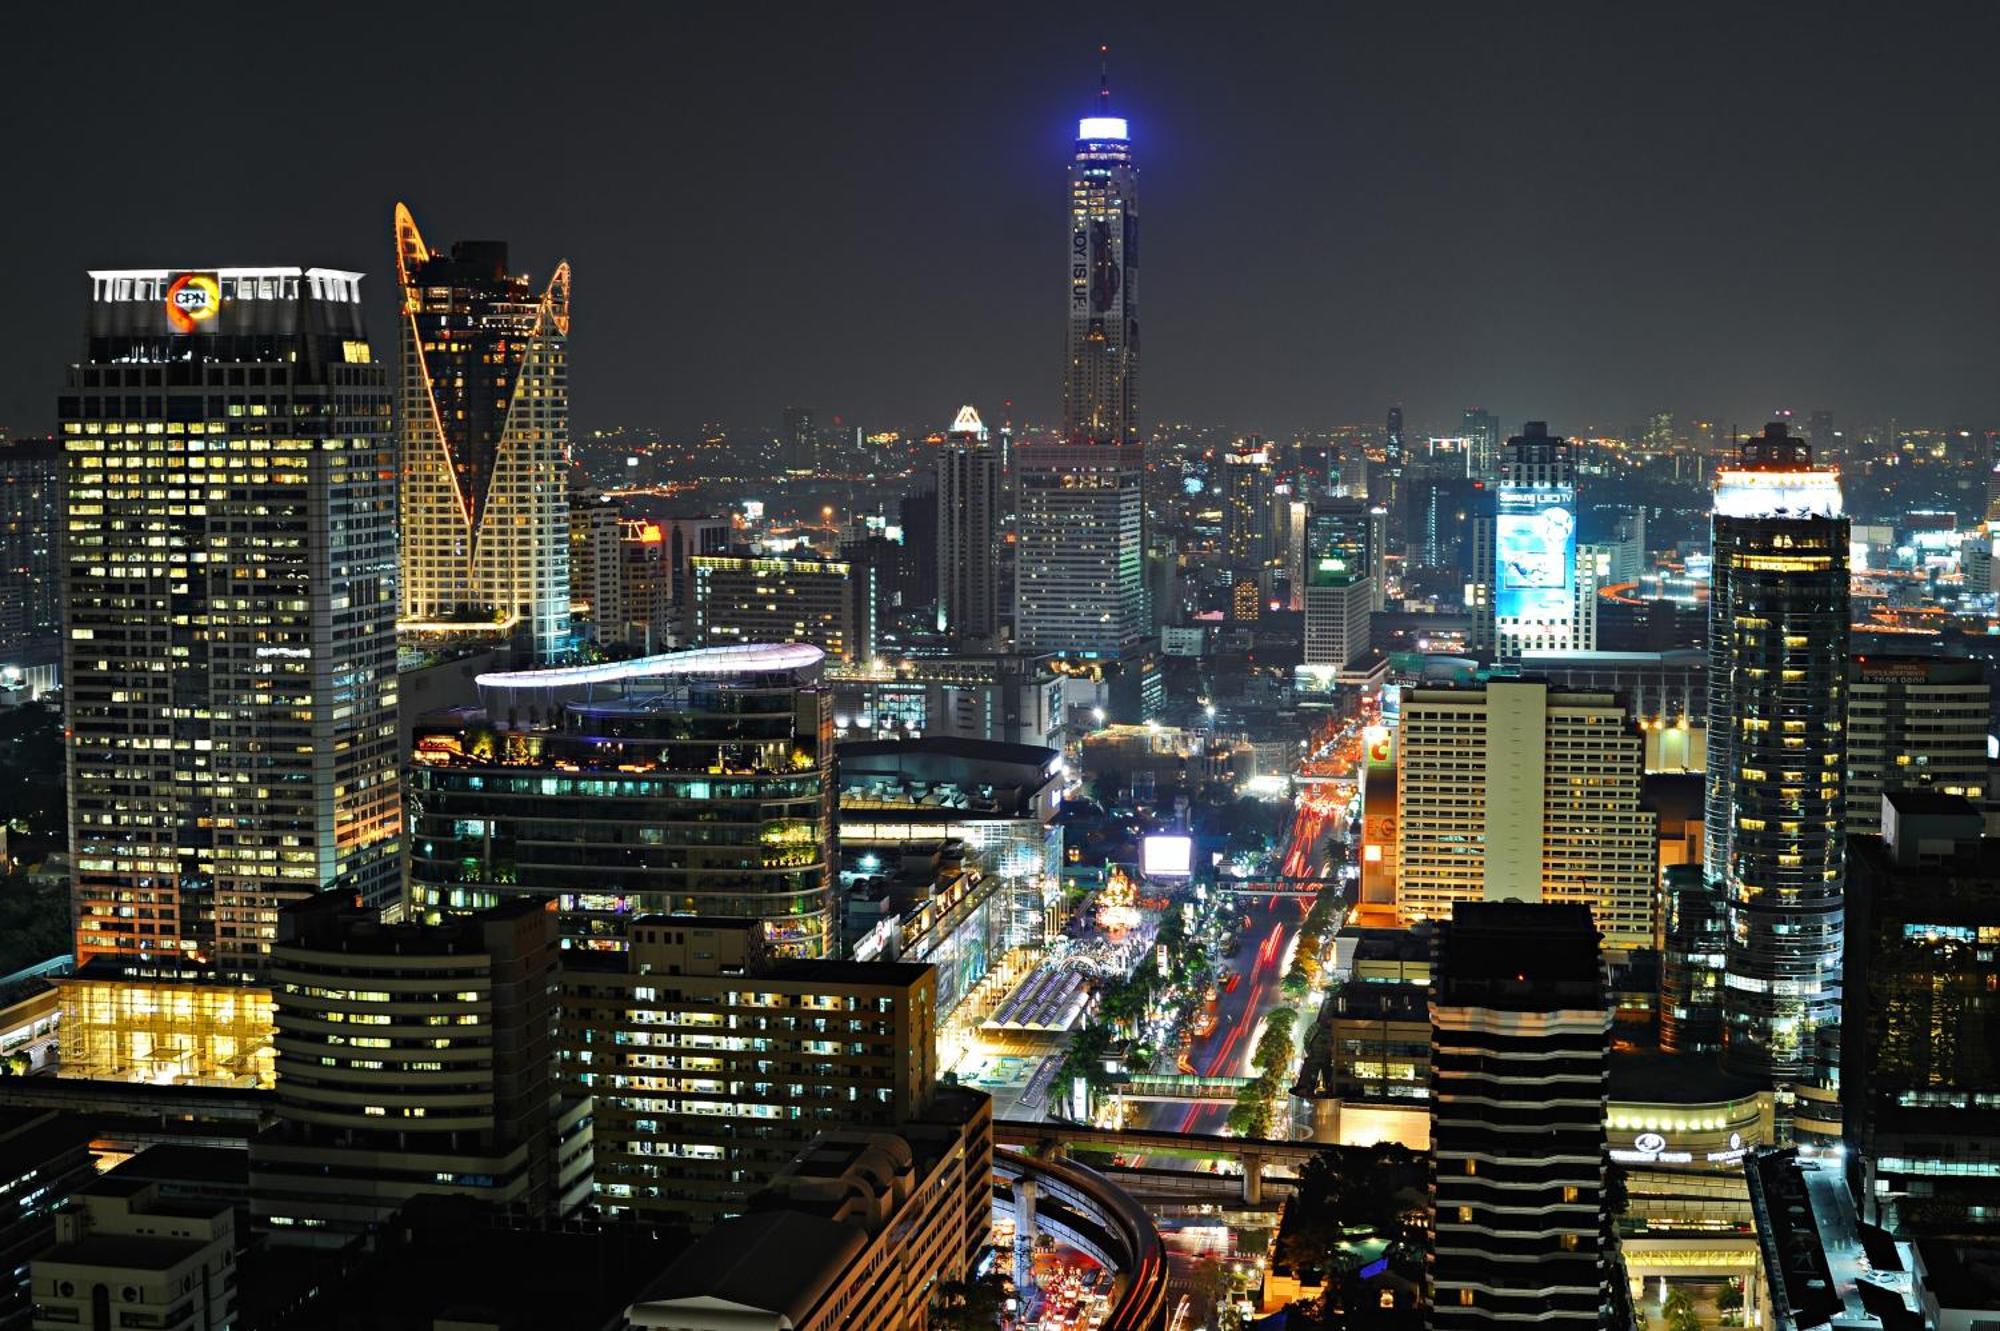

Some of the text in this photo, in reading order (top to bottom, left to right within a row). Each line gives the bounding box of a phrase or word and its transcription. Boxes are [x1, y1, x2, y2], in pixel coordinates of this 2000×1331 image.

[1073, 263, 1087, 279] IS
[175, 292, 206, 304] CPN
[1561, 493, 1573, 502] TV
